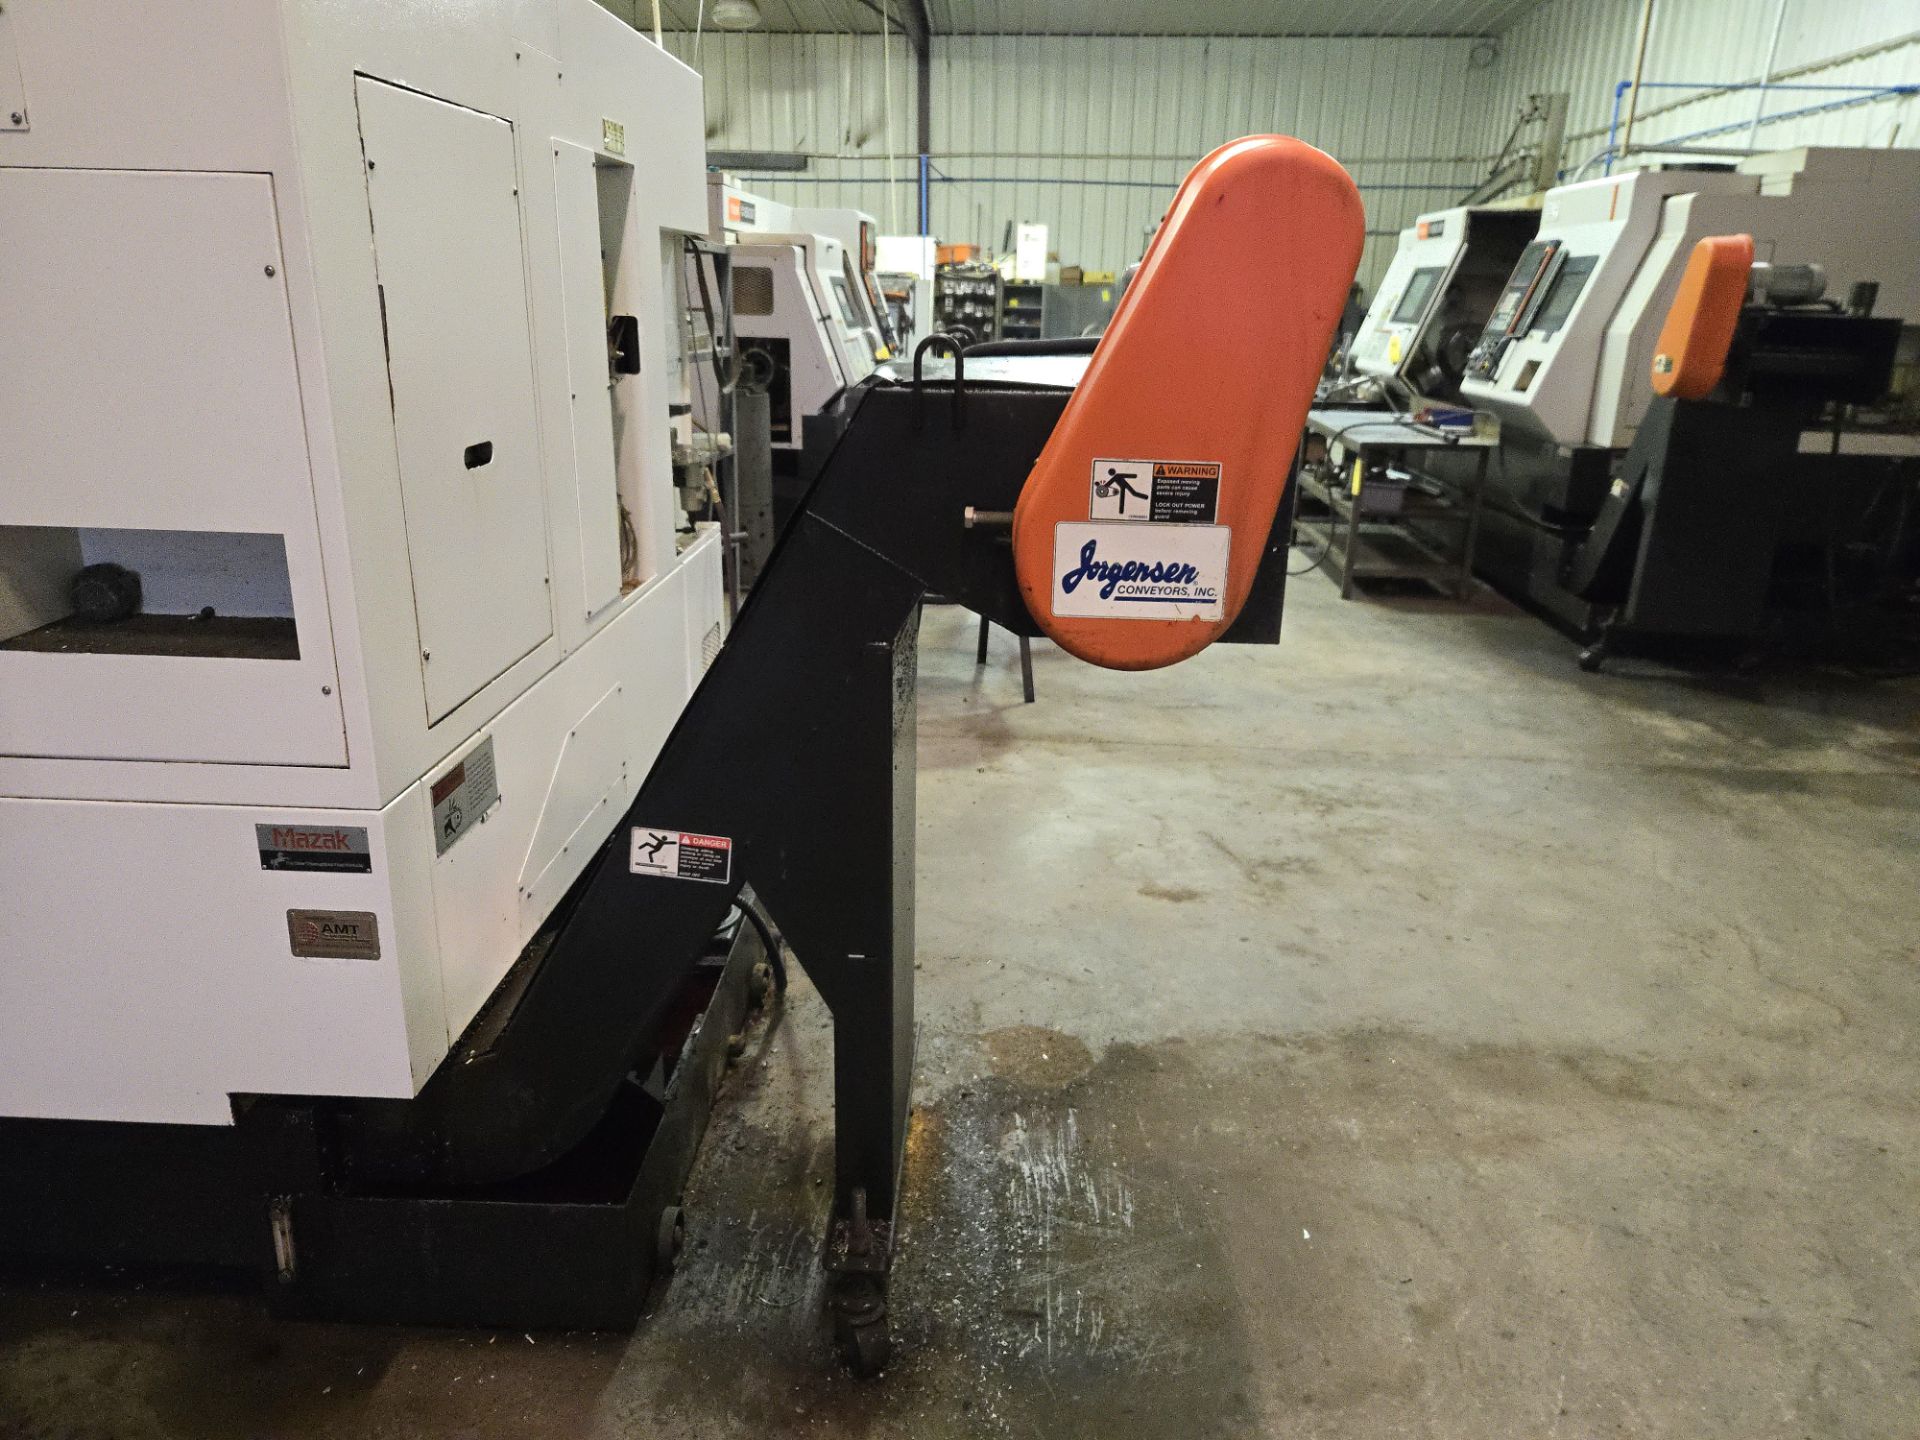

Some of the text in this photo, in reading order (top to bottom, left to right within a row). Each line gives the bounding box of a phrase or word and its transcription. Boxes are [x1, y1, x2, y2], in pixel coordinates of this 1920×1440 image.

[1167, 466, 1217, 476] WARNING
[1061, 538, 1200, 600] Jorgensen
[1117, 585, 1218, 597] CONVEYORS, INC.
[271, 827, 352, 851] Mazak
[692, 837, 727, 848] DANGER
[321, 923, 360, 934] AMT
